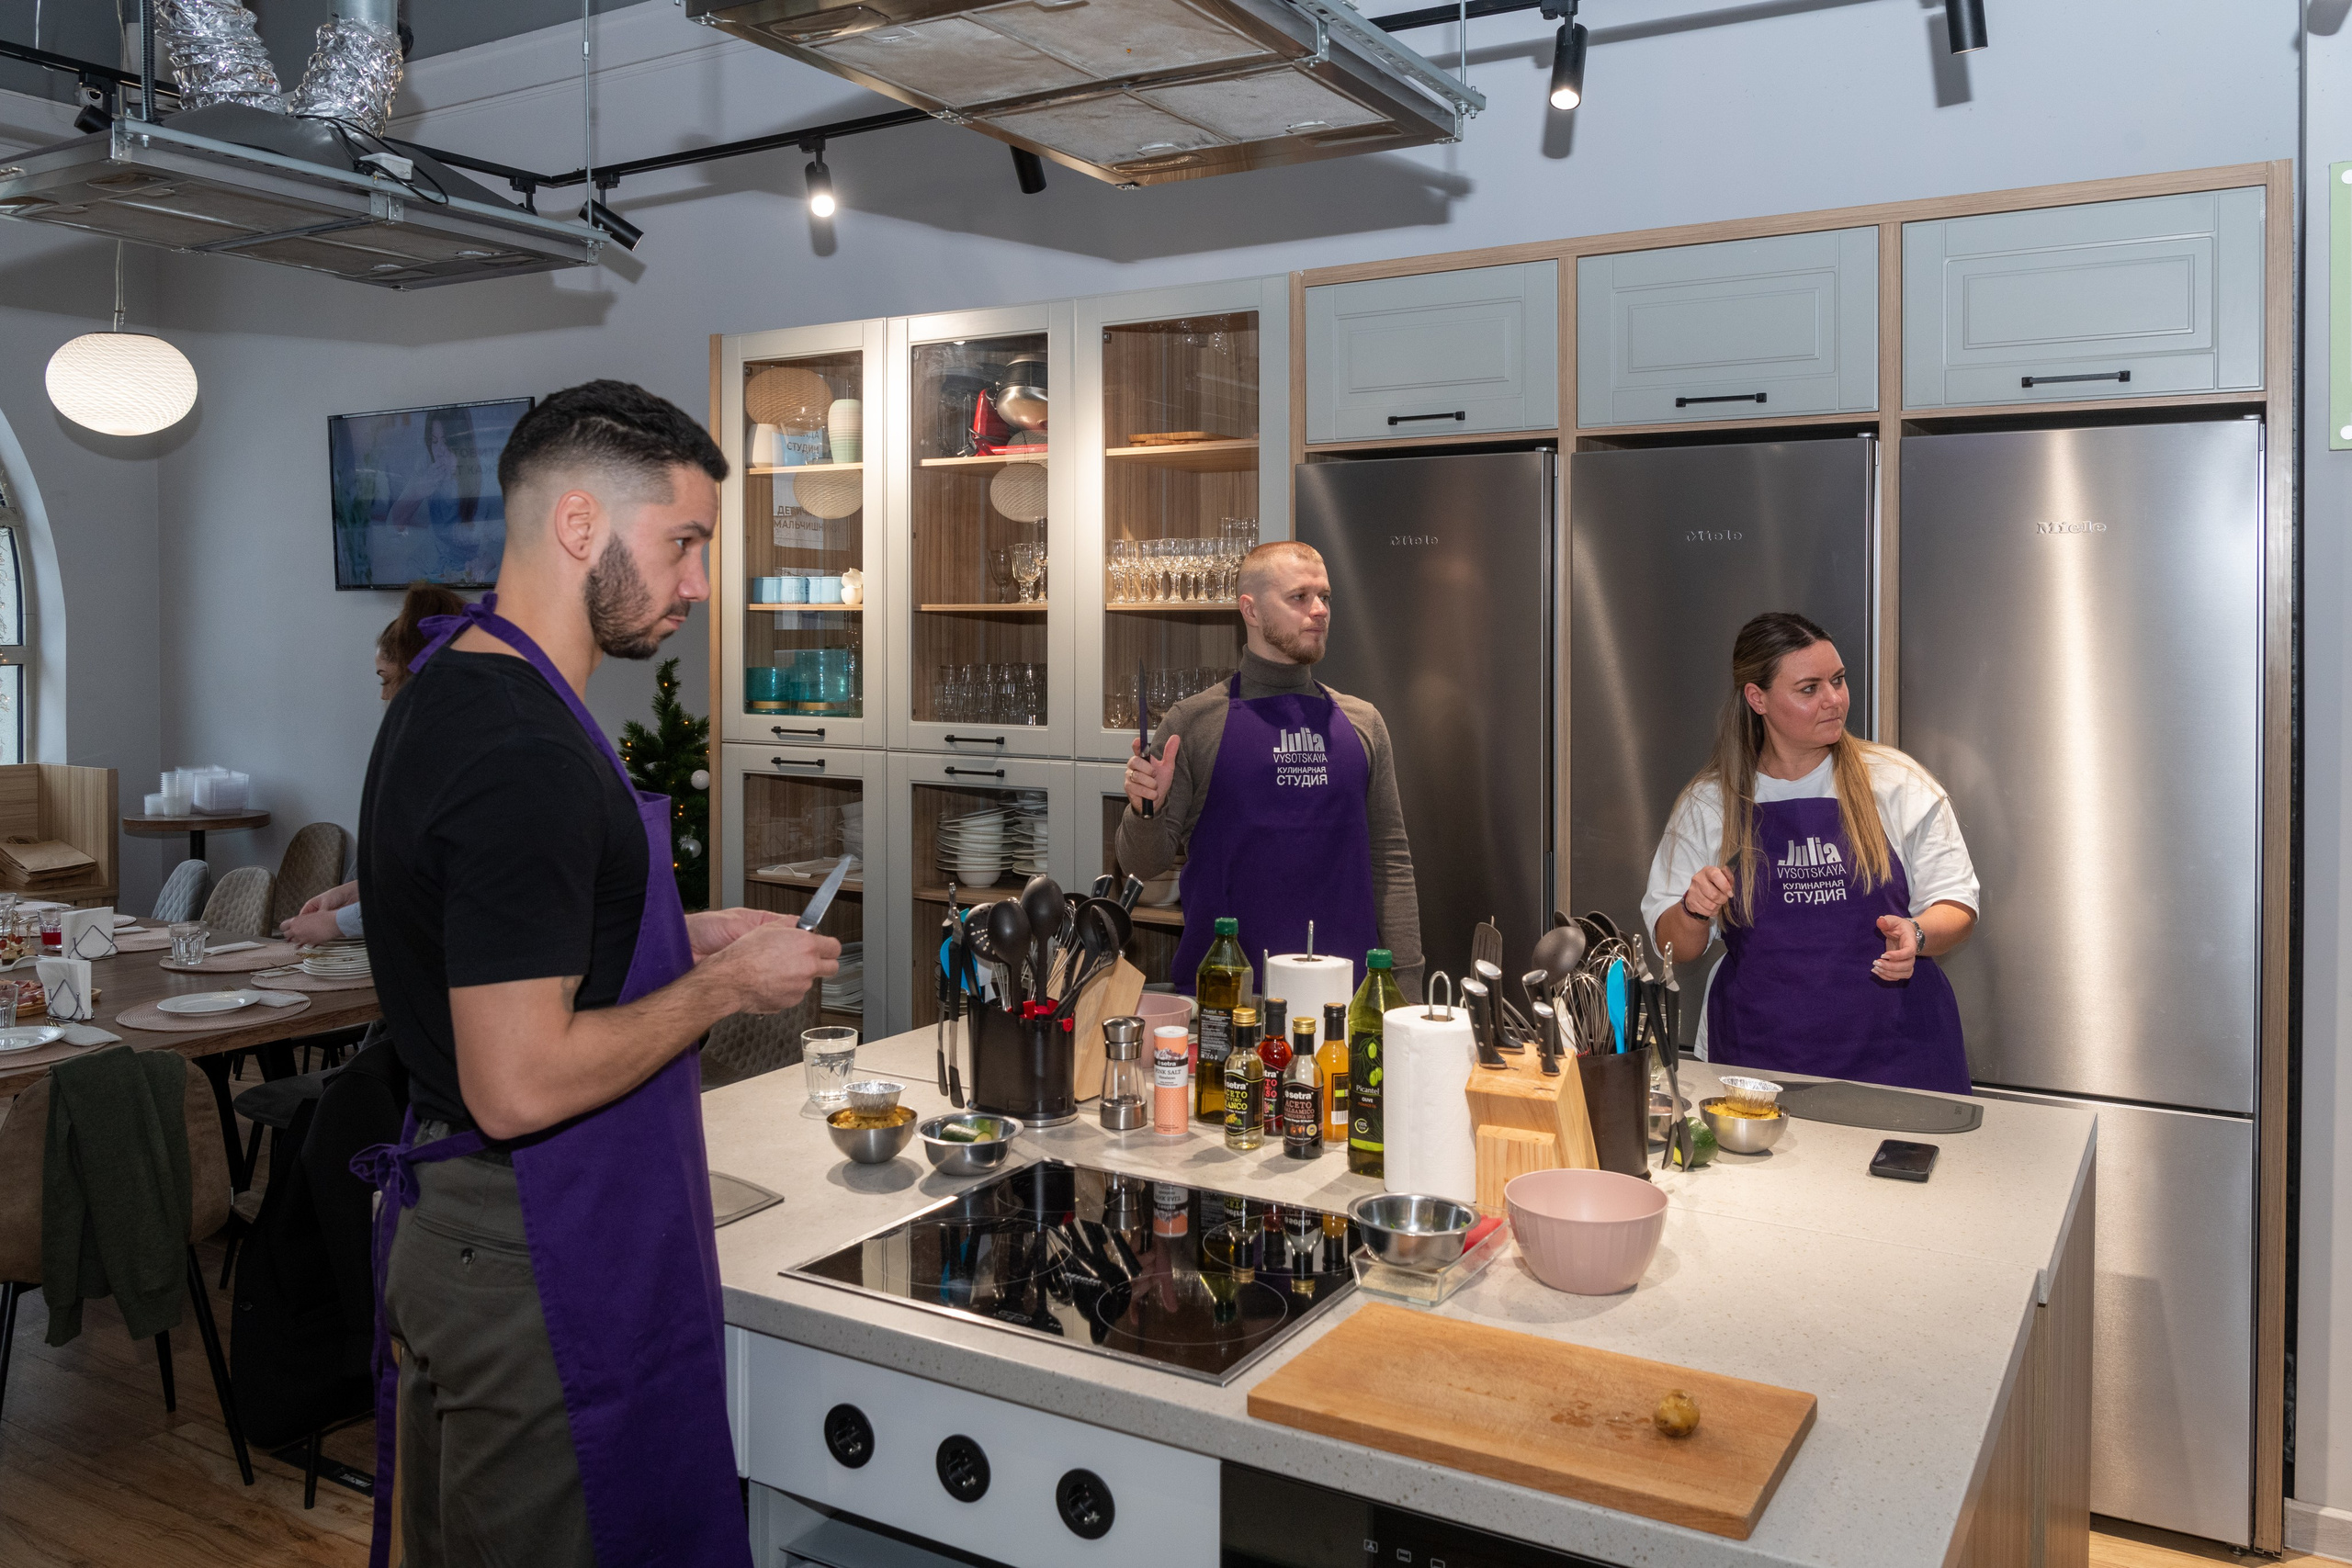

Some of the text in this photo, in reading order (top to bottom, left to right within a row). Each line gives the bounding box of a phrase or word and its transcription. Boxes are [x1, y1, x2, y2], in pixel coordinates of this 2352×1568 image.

[2037, 520, 2107, 534] Miele
[1273, 727, 1326, 752] Julia
[1273, 753, 1328, 763] VYSOTSKAYA
[1276, 774, 1328, 787] СТУДИЯ
[1777, 837, 1842, 866] Julia
[1777, 863, 1847, 879] VYSOTSKAYA
[1782, 879, 1844, 890] КУЛИНАРНАЯ
[1783, 888, 1847, 905] СТУДИЯ
[1289, 1091, 1312, 1100] setra
[1355, 1084, 1380, 1095] Picantel
